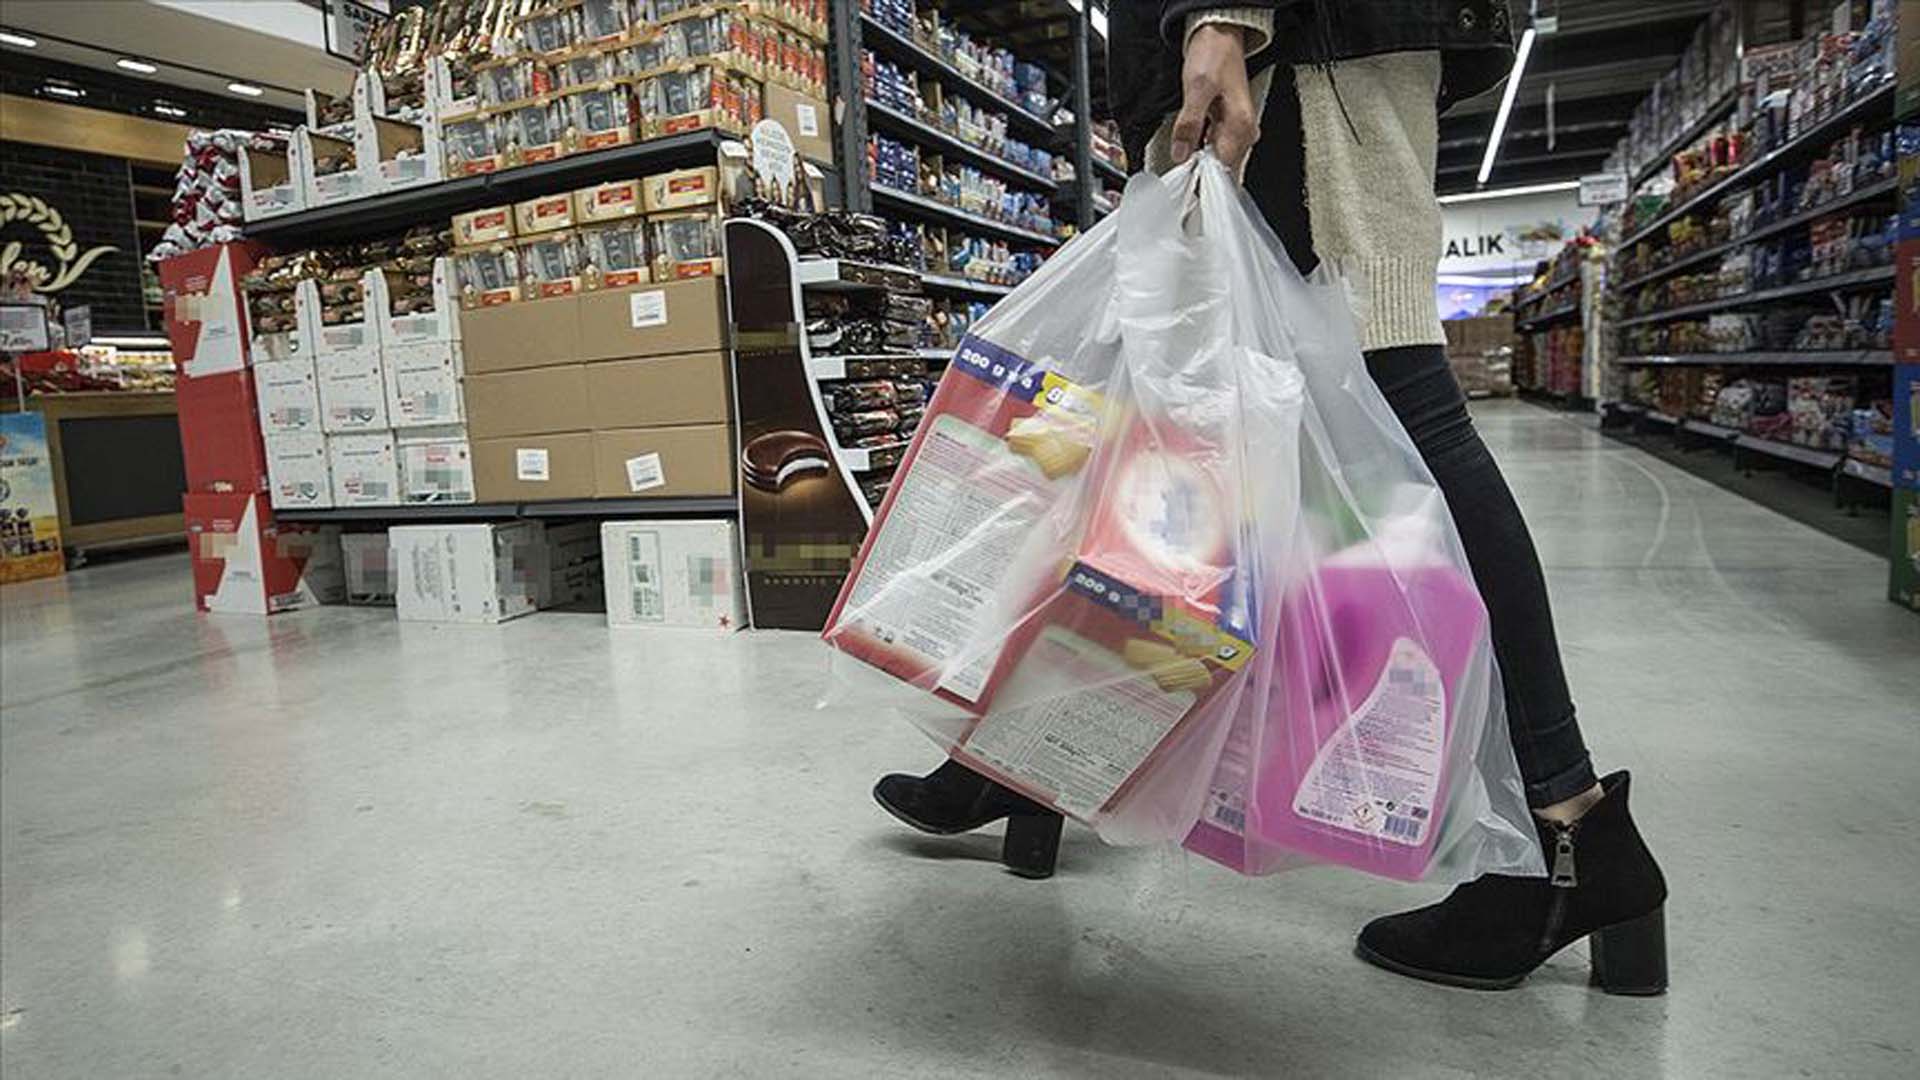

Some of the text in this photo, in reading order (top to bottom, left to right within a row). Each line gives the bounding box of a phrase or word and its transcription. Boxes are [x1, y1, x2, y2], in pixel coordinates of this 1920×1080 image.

[1445, 234, 1504, 258] ALIK
[960, 348, 991, 369] 200
[1074, 572, 1106, 594] 200
